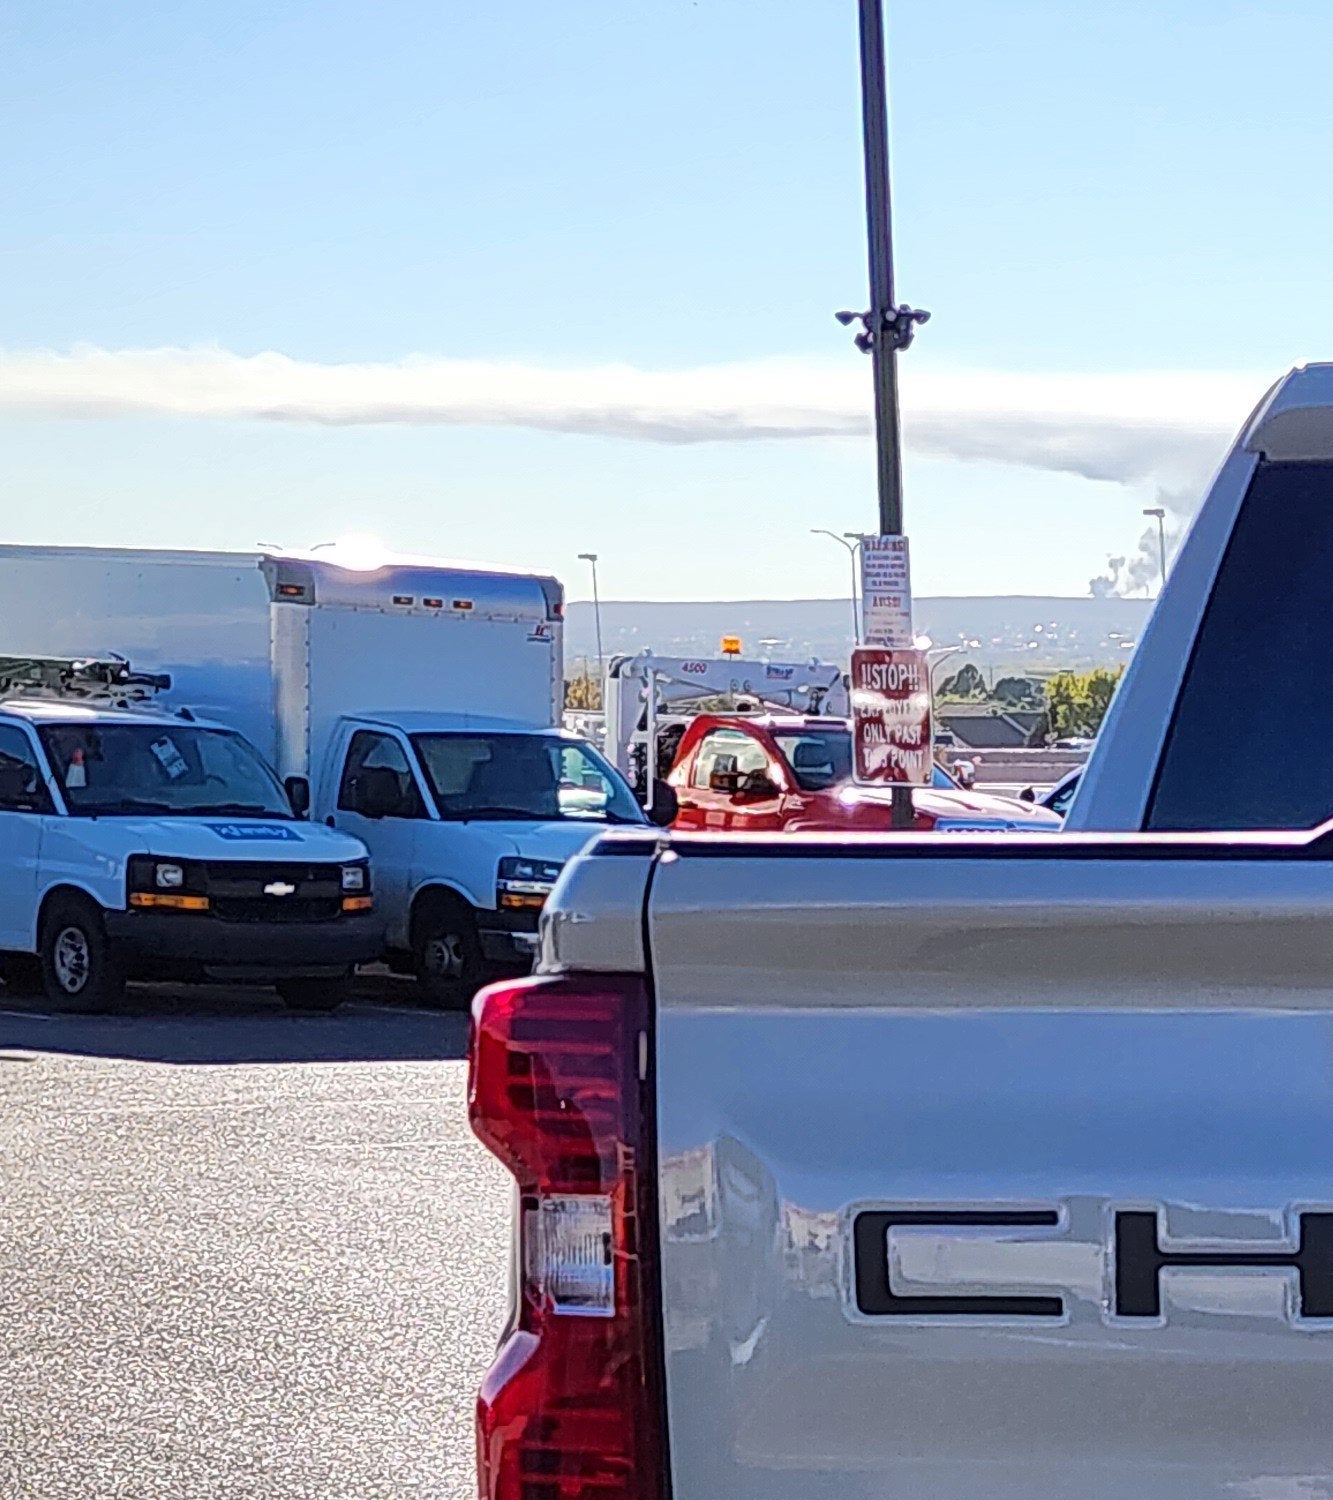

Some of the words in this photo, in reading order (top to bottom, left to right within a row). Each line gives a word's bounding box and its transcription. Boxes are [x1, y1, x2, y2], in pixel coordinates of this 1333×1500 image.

[863, 723, 892, 744] ONLY
[894, 725, 922, 745] PAST
[890, 749, 923, 769] POINT
